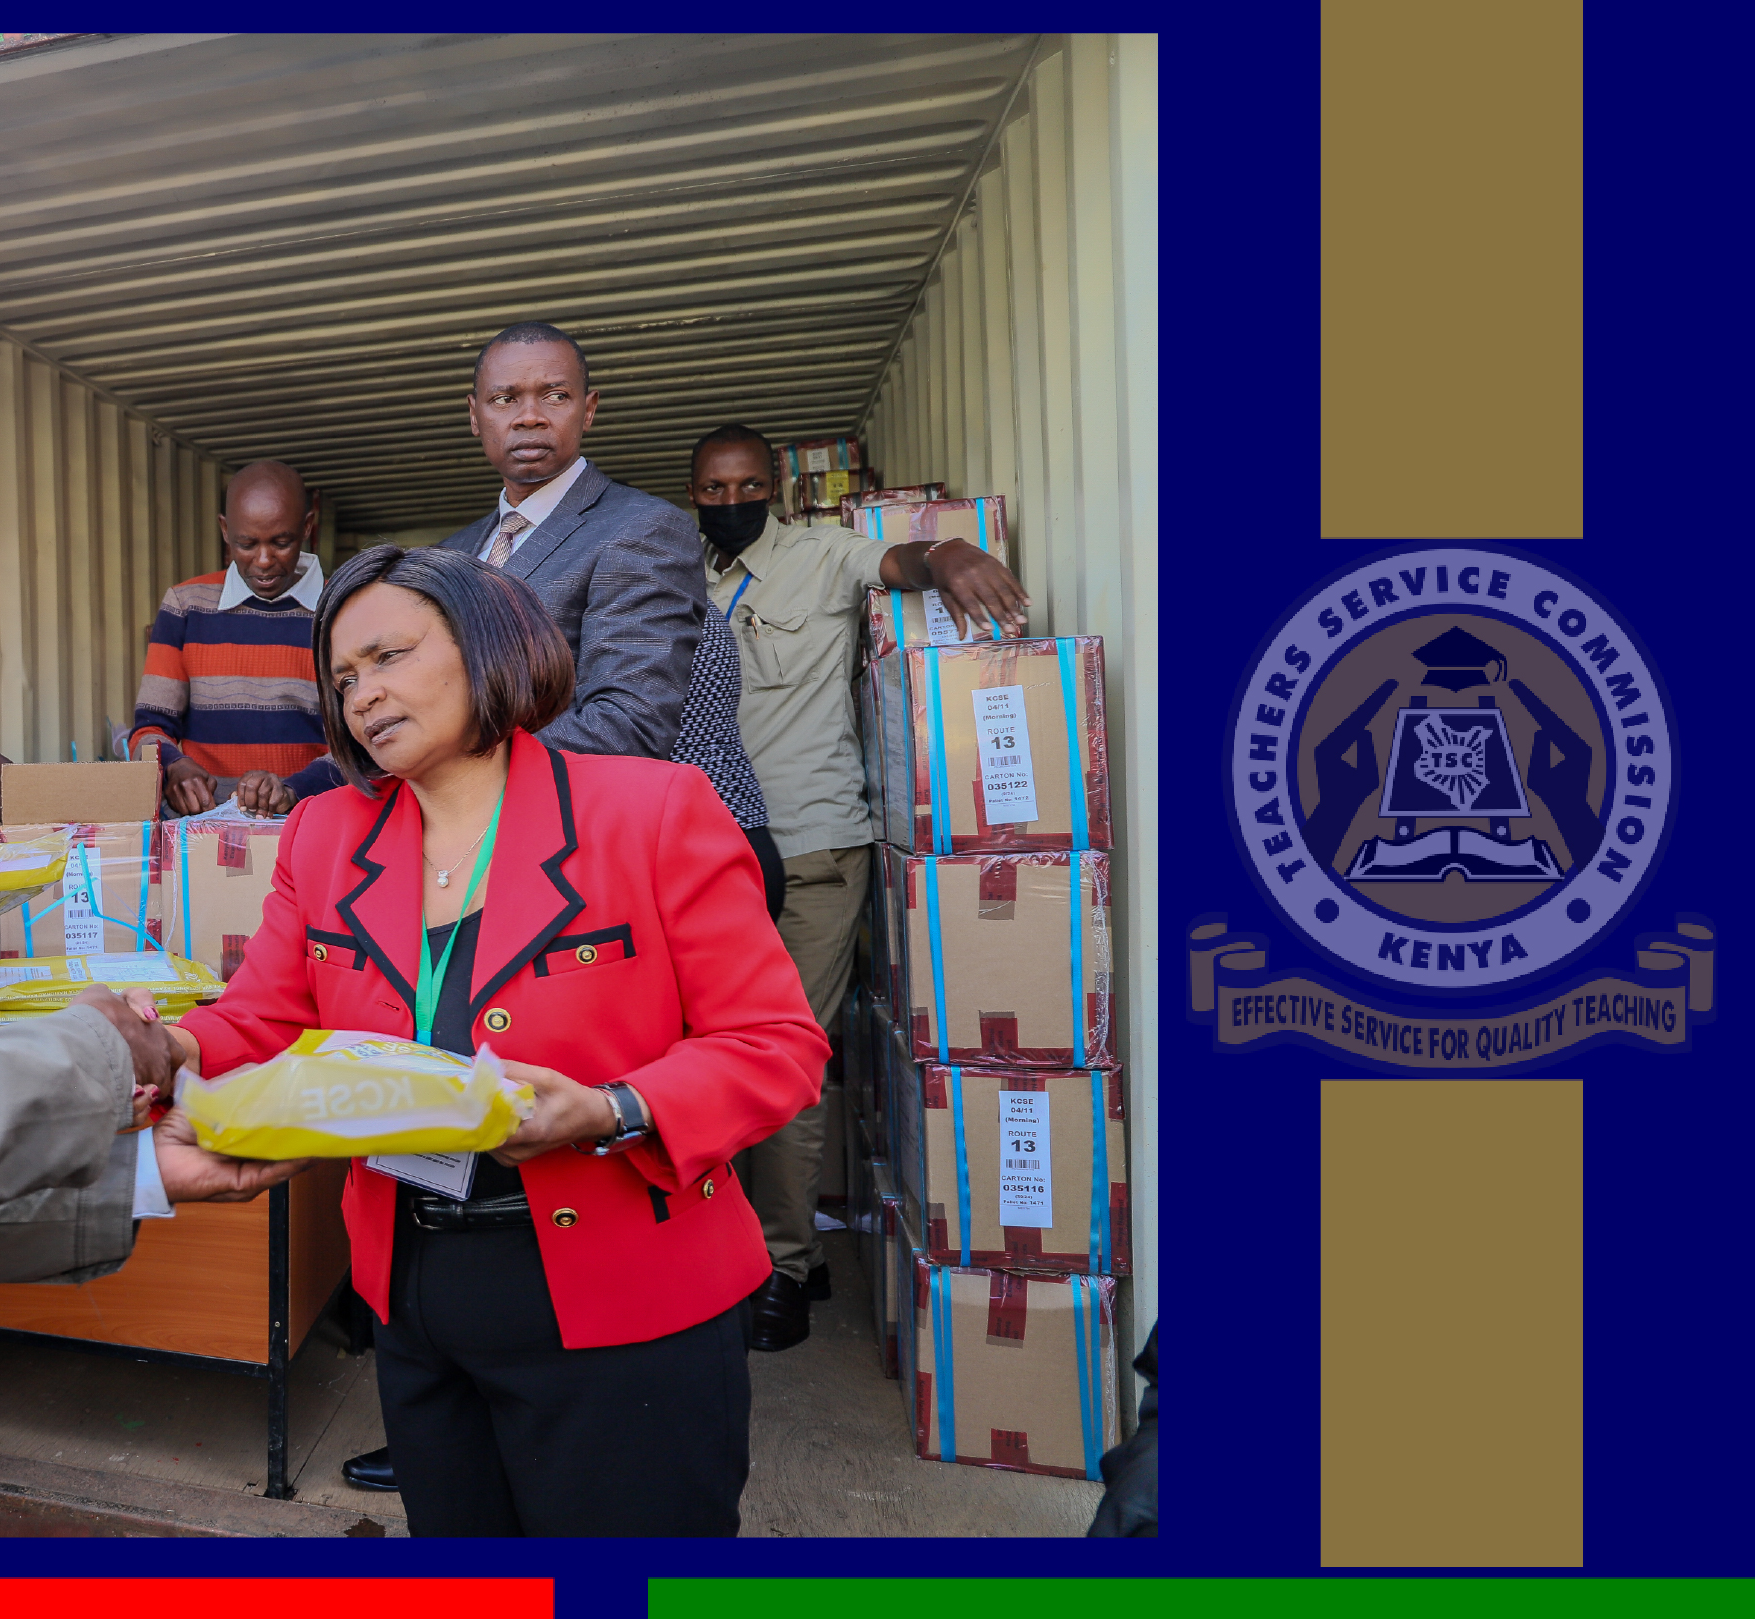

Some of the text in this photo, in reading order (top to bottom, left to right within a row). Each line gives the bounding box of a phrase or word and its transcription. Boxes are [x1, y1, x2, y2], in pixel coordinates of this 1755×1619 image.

[987, 727, 1016, 735] ROUTE
[991, 736, 1016, 750] 13
[984, 772, 1014, 780] CARTON
[987, 781, 1028, 791] 035122
[71, 892, 89, 903] 13
[1011, 1139, 1036, 1153] 13
[1002, 1184, 1045, 1193] 035116
